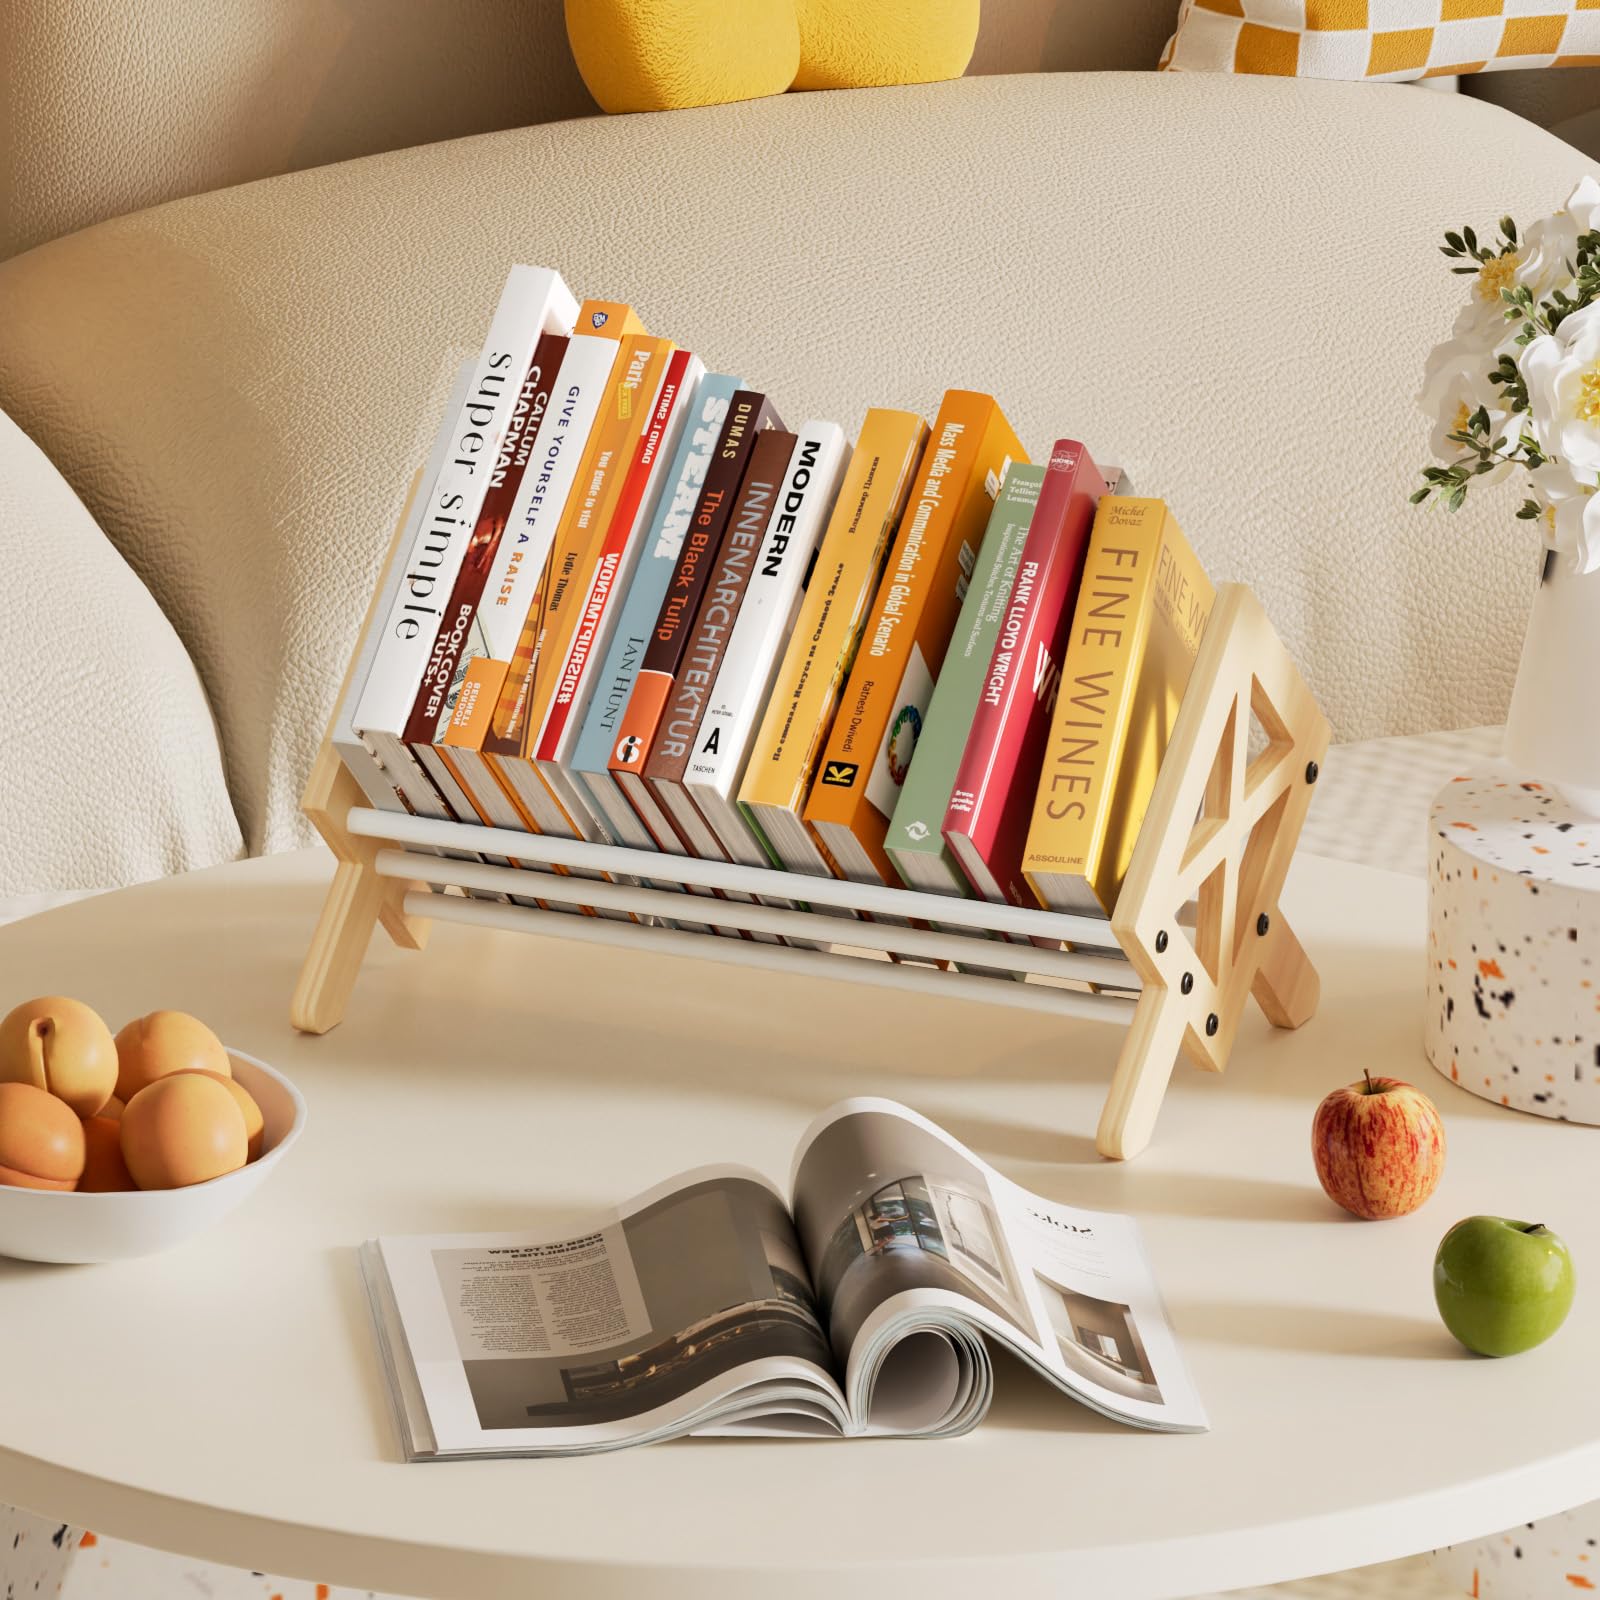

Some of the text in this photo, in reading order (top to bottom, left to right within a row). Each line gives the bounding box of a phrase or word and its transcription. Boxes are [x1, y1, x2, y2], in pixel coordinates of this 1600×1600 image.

[624, 350, 652, 389] Paris
[491, 365, 541, 489] CHAPMAN
[514, 391, 548, 467] CALLUM
[598, 450, 613, 468] You
[722, 403, 752, 459] DUMAS
[396, 351, 513, 640] super simple
[496, 386, 580, 607] GIVE YOURSELF A RAISE
[654, 396, 730, 561] STEAM
[761, 440, 822, 577] MODERN
[549, 552, 578, 611] Lydie Thomas
[658, 489, 725, 641] The Black Tulip
[869, 422, 966, 657] Mass Media and Communication in Global Scenario
[985, 526, 1030, 623] The Art of Knitting
[660, 481, 774, 758] INNENARCHITEKTUR
[984, 561, 1039, 706] FRANK LLOYD WRIGHT
[1082, 547, 1139, 648] FINE
[424, 631, 451, 687] TUTS+
[424, 604, 473, 718] BOOK COVER
[600, 637, 645, 733] IAN HUNT
[702, 727, 720, 755] A
[842, 680, 875, 753] Ratnesh Dwivedi
[1046, 671, 1114, 821] WINES
[692, 764, 715, 774] TASCHEN
[1028, 854, 1084, 865] ASSOULINE
